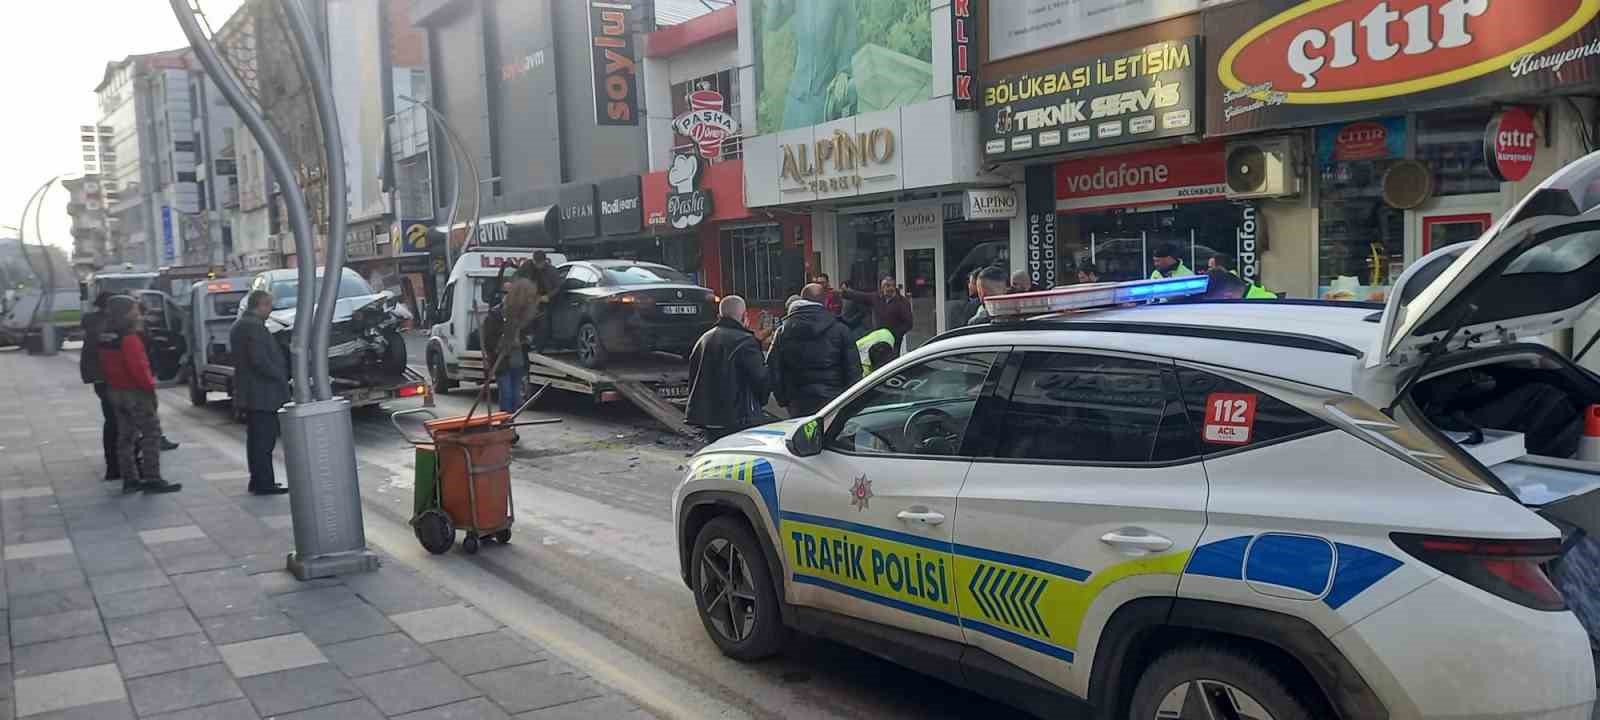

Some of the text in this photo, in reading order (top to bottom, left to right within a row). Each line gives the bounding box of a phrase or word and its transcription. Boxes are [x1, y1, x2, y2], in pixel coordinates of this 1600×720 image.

[594, 10, 635, 121] soylu
[1286, 0, 1490, 89] çıtır
[985, 43, 1191, 107] BÖLÜKBAŞI İLETİŞİM
[682, 111, 732, 130] PASHA
[1014, 98, 1087, 131] TEKNİK
[1090, 80, 1181, 120] SERVİS
[1499, 129, 1534, 150] çıtır
[1067, 163, 1169, 193] vodafone
[1214, 399, 1248, 422] 112
[791, 531, 949, 605] TRAFİK POLİSİ
